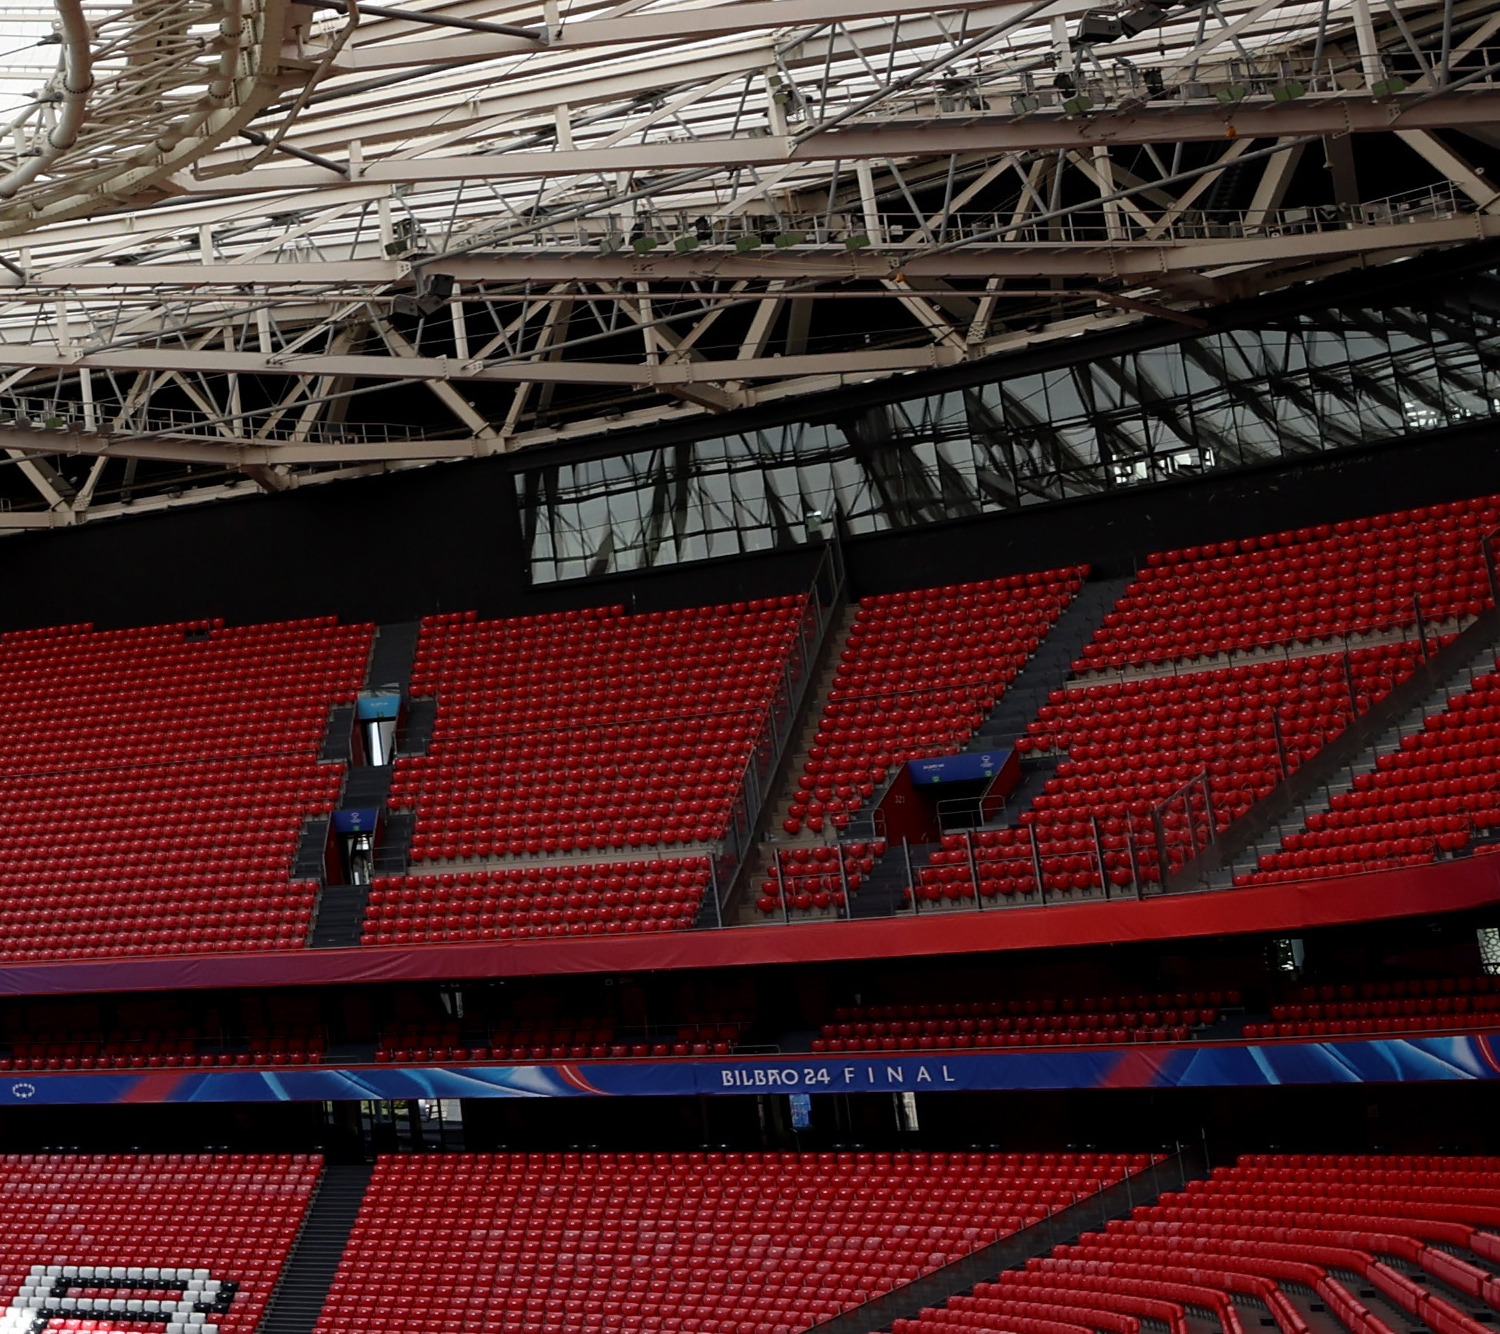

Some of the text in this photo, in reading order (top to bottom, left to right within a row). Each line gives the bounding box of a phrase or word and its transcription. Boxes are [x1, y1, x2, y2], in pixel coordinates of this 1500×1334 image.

[721, 1065, 955, 1086] BILBAO 24 FINAL
